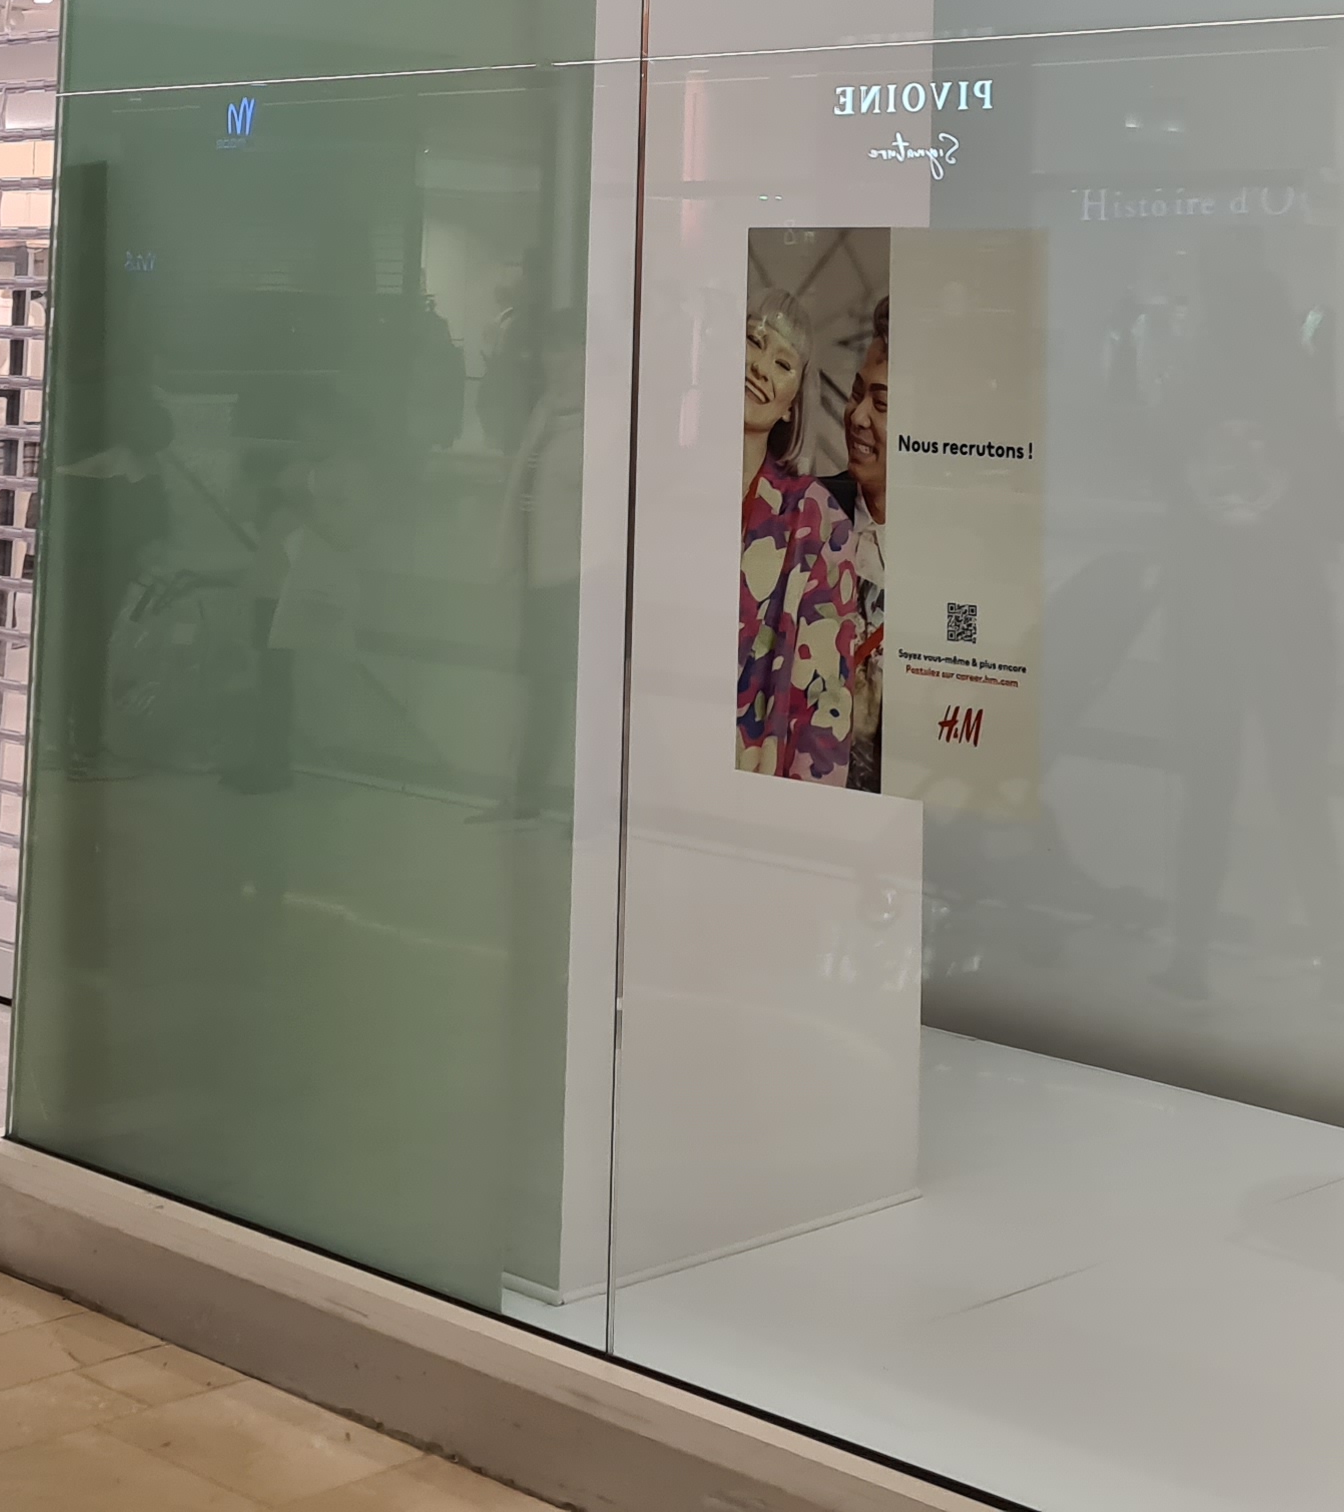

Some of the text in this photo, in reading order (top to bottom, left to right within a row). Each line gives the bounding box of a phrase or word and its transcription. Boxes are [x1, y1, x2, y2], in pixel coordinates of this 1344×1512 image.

[898, 434, 939, 454] Nous
[943, 441, 1025, 459] recrutons
[898, 648, 922, 661] Soyez
[923, 654, 970, 666] vous-même
[979, 659, 997, 670] plus
[997, 663, 1027, 674] encore
[937, 704, 984, 748] H&M
